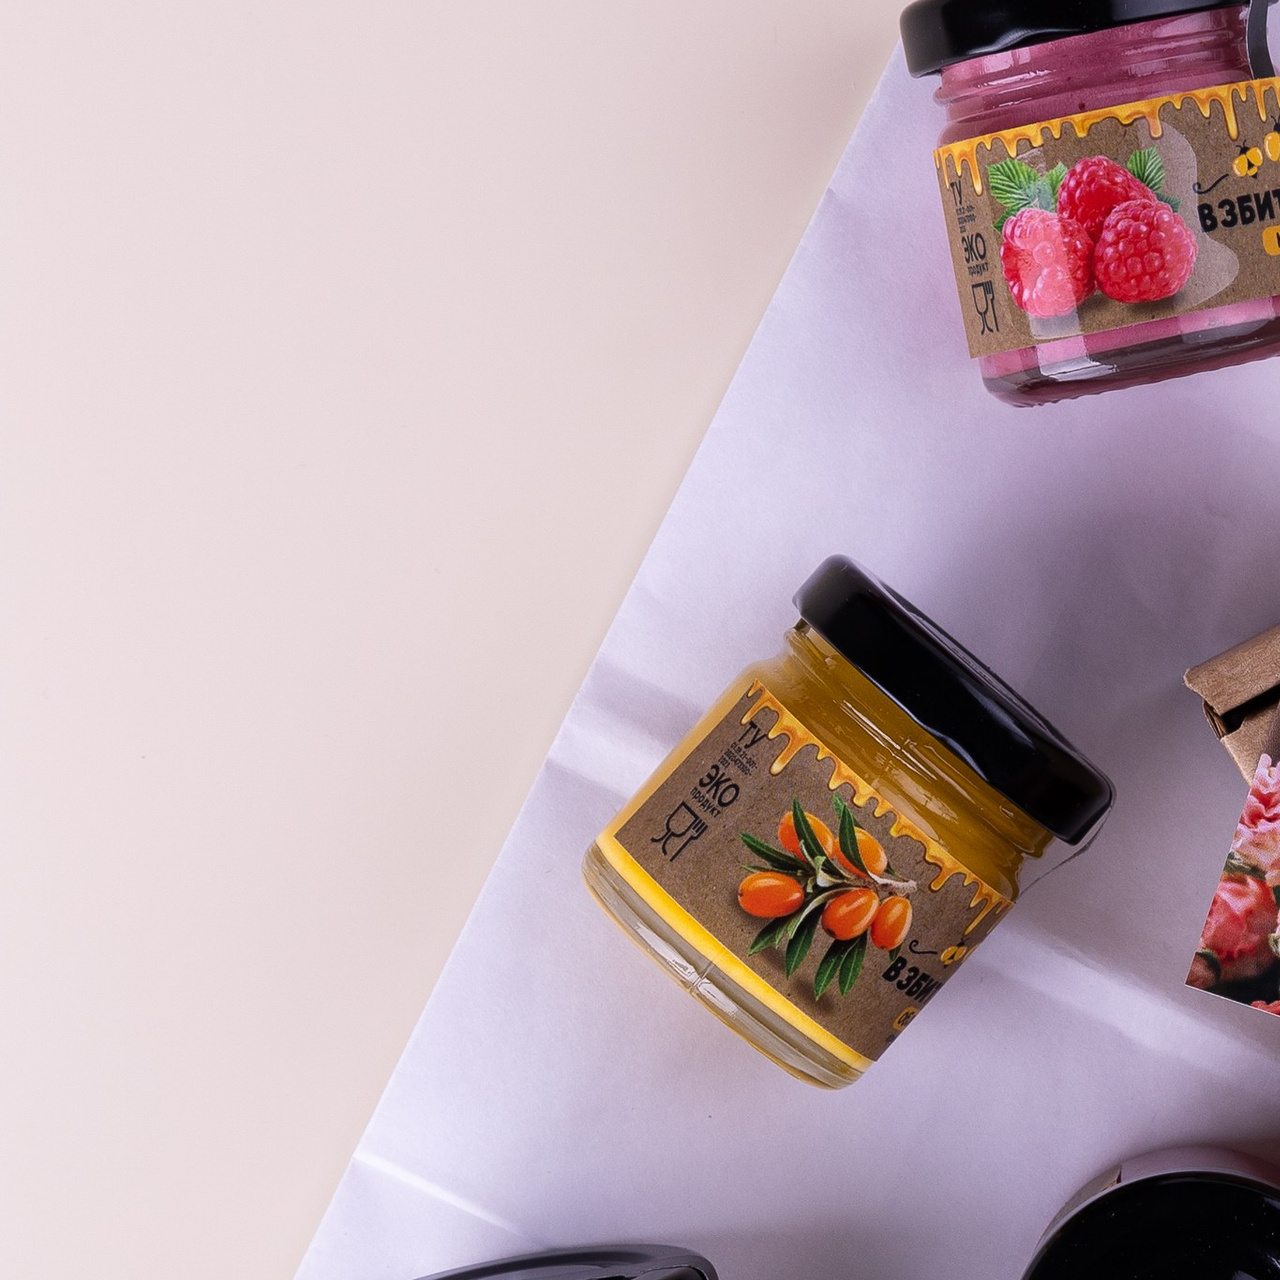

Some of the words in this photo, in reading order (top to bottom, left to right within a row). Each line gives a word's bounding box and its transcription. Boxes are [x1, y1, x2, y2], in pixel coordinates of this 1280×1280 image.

[961, 232, 987, 264] ЭКО
[738, 720, 768, 749] ТУ
[690, 786, 721, 818] продукт
[699, 764, 740, 808] ЭКО
